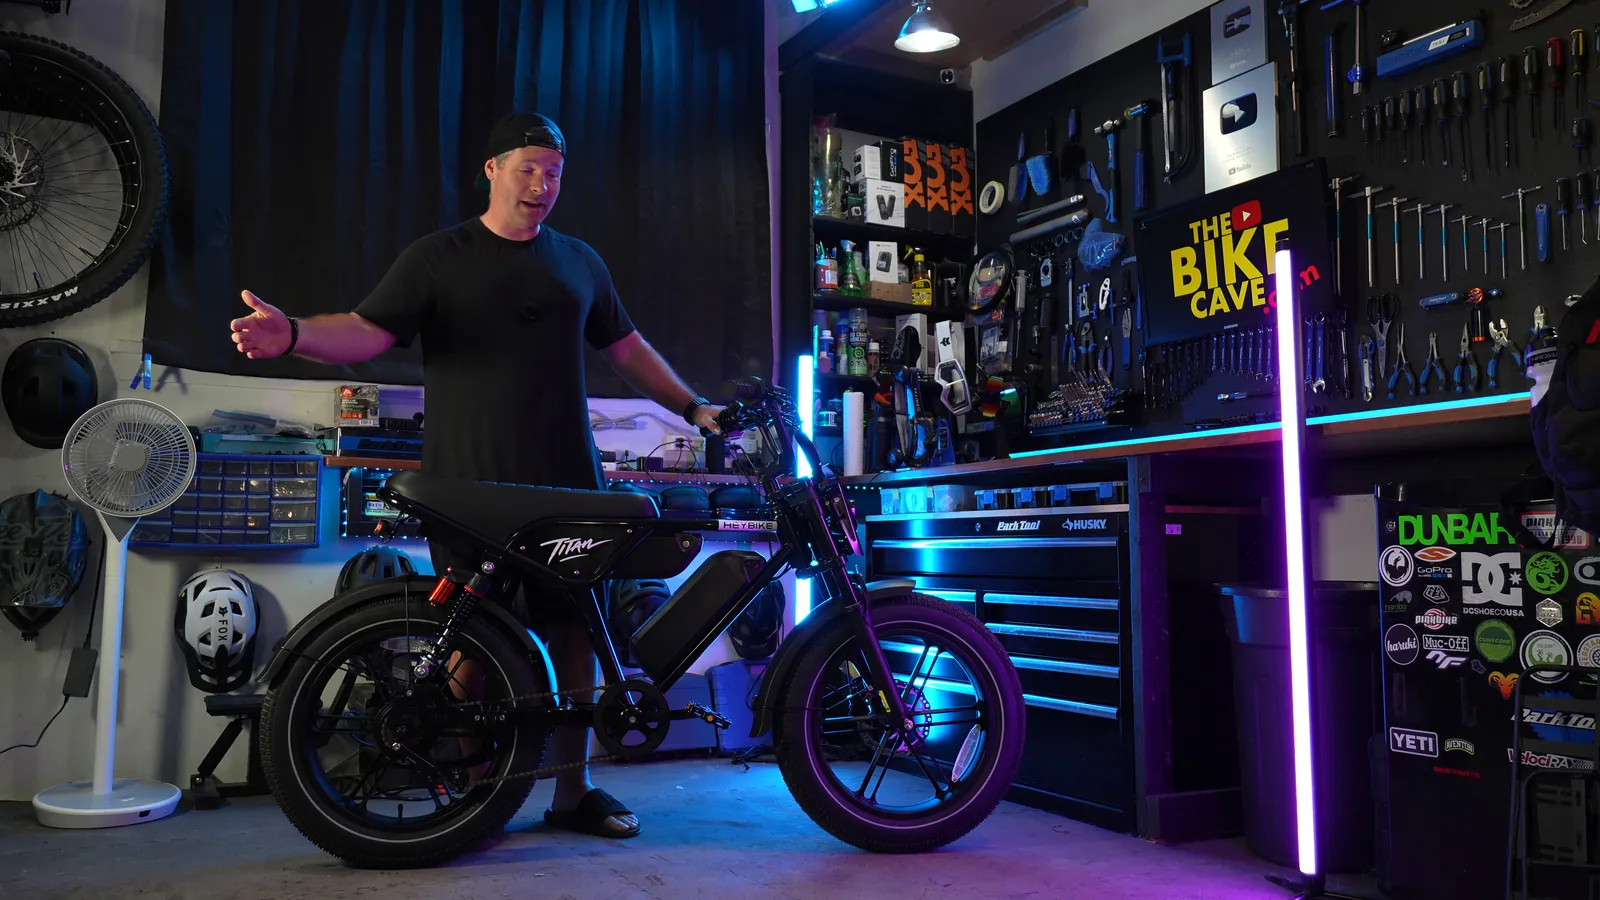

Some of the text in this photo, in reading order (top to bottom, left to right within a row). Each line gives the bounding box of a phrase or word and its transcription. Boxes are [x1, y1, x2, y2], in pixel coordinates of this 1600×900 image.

[1189, 211, 1232, 244] THE
[0, 286, 79, 310] MAXXIS
[1190, 276, 1266, 319] CAVE
[723, 521, 774, 531] HEYBIKE
[997, 521, 1019, 531] Park
[1073, 519, 1107, 531] HUSKY
[1417, 566, 1453, 574] GoPro
[1463, 607, 1524, 617] DCSHOECOUSA
[217, 619, 229, 642] FOX
[1387, 636, 1418, 652] haruki
[1424, 636, 1467, 649] Muc-Off
[1393, 732, 1434, 752] YETI
[1446, 739, 1473, 753] AVENTON
